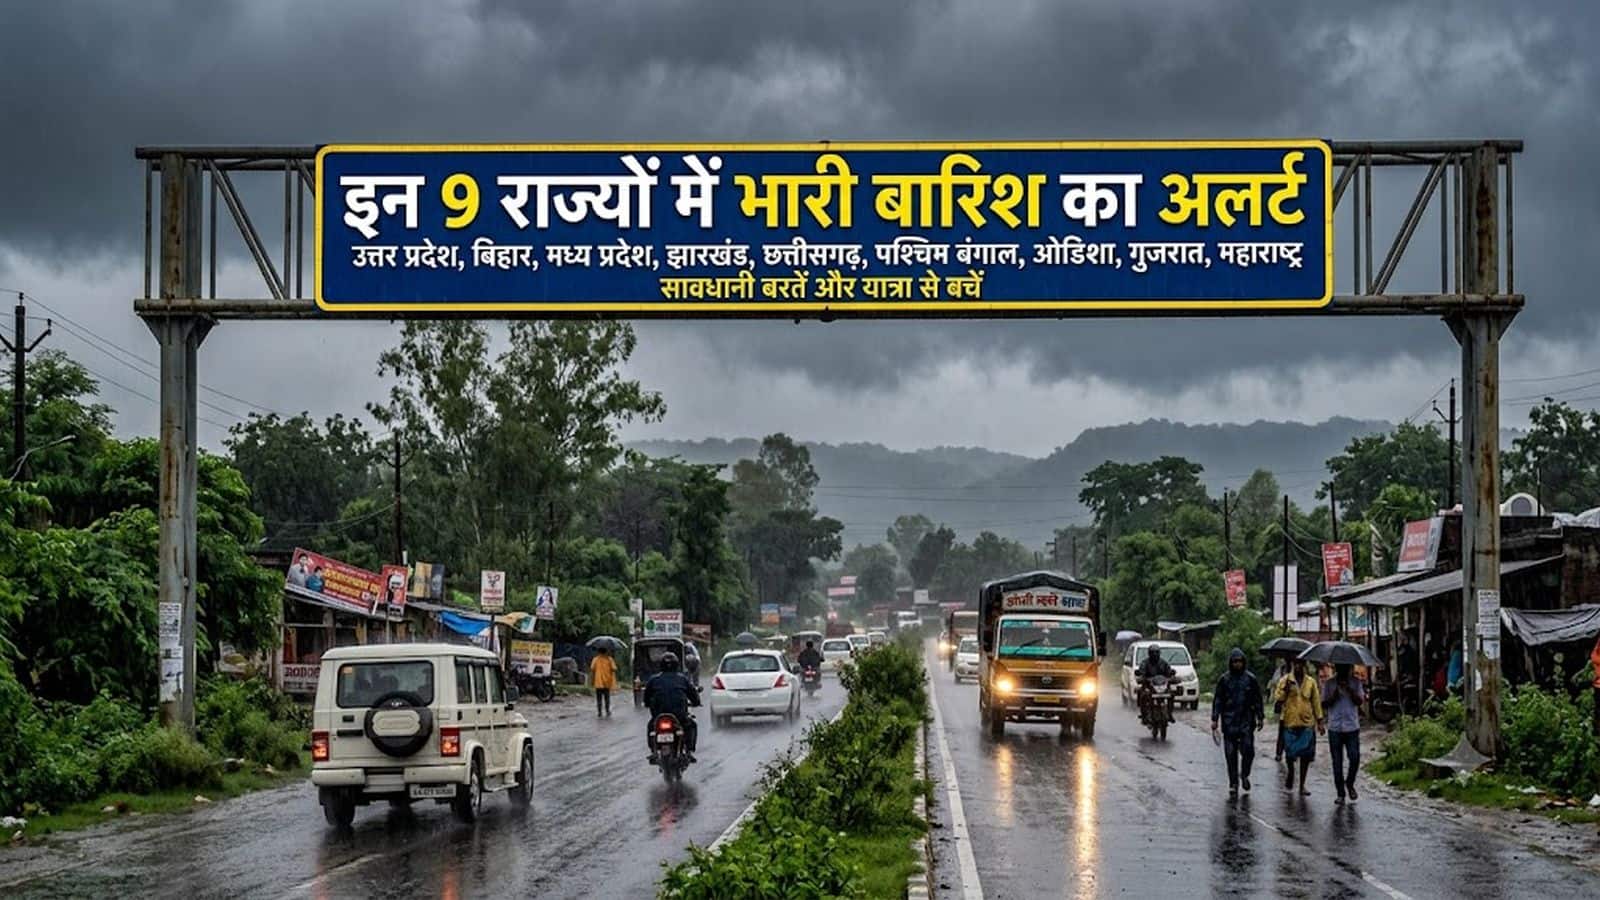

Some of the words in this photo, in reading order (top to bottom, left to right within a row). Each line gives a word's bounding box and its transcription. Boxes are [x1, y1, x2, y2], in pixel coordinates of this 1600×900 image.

[340, 175, 425, 238] इन
[442, 174, 483, 229] 9
[497, 154, 660, 228] राज्यों
[671, 154, 722, 228] में
[735, 153, 858, 228] भारी
[872, 154, 1046, 228] बारिश
[1060, 173, 1142, 228] का
[1158, 152, 1307, 228] अलर्ट
[351, 245, 398, 268] उत्तर
[403, 239, 465, 271] प्रदेश,
[472, 237, 539, 271] बिहार,
[545, 245, 592, 268] मध्य
[598, 239, 660, 271] प्रदेश,
[665, 239, 756, 269] झारखंड,
[763, 238, 869, 271] छत्तीसगढ़,
[875, 236, 950, 267] पश्चिम
[956, 238, 1025, 270] बंगाल,
[1033, 236, 1122, 269] ओडिशा,
[1129, 242, 1211, 272] गुजरात,
[1218, 242, 1304, 268] महाराष्ट्र
[660, 270, 756, 299] सावधानी
[761, 270, 810, 299] बरतें
[814, 270, 856, 299] और
[862, 276, 913, 299] यात्रा
[919, 270, 940, 299] से
[946, 270, 984, 299] बचें
